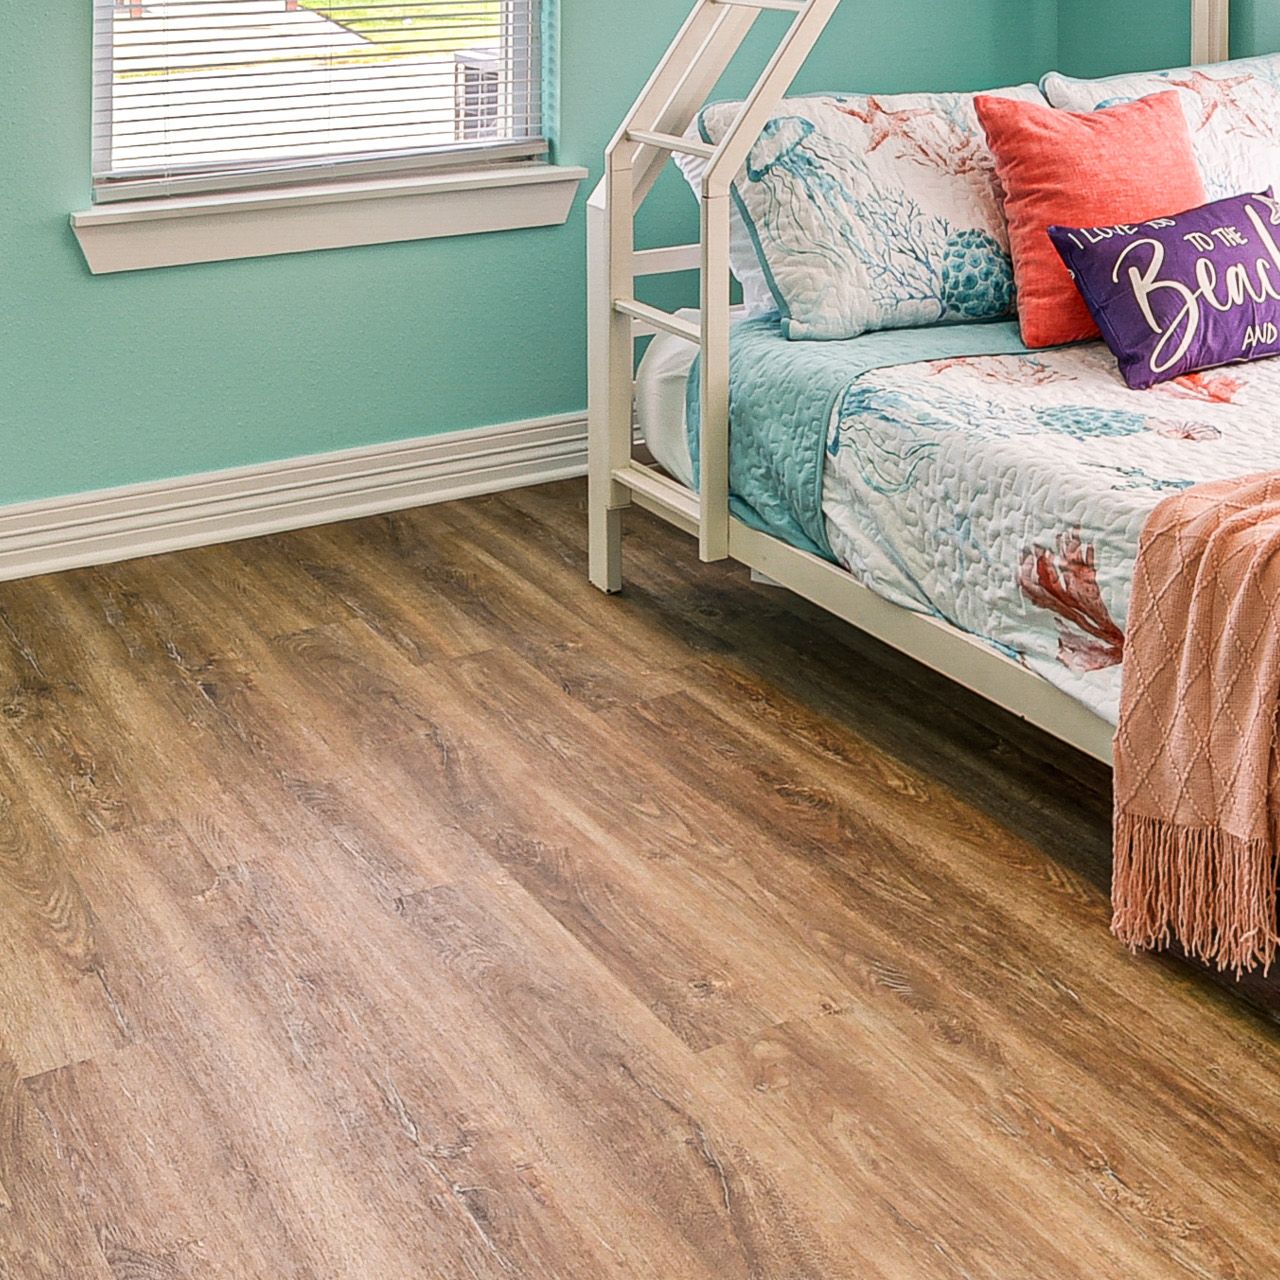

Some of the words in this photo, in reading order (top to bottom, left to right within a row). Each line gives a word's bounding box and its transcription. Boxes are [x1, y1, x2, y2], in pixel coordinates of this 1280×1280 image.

[1067, 233, 1084, 249] I
[1183, 232, 1214, 252] TO
[1211, 226, 1248, 247] THE
[1241, 322, 1278, 351] AND
